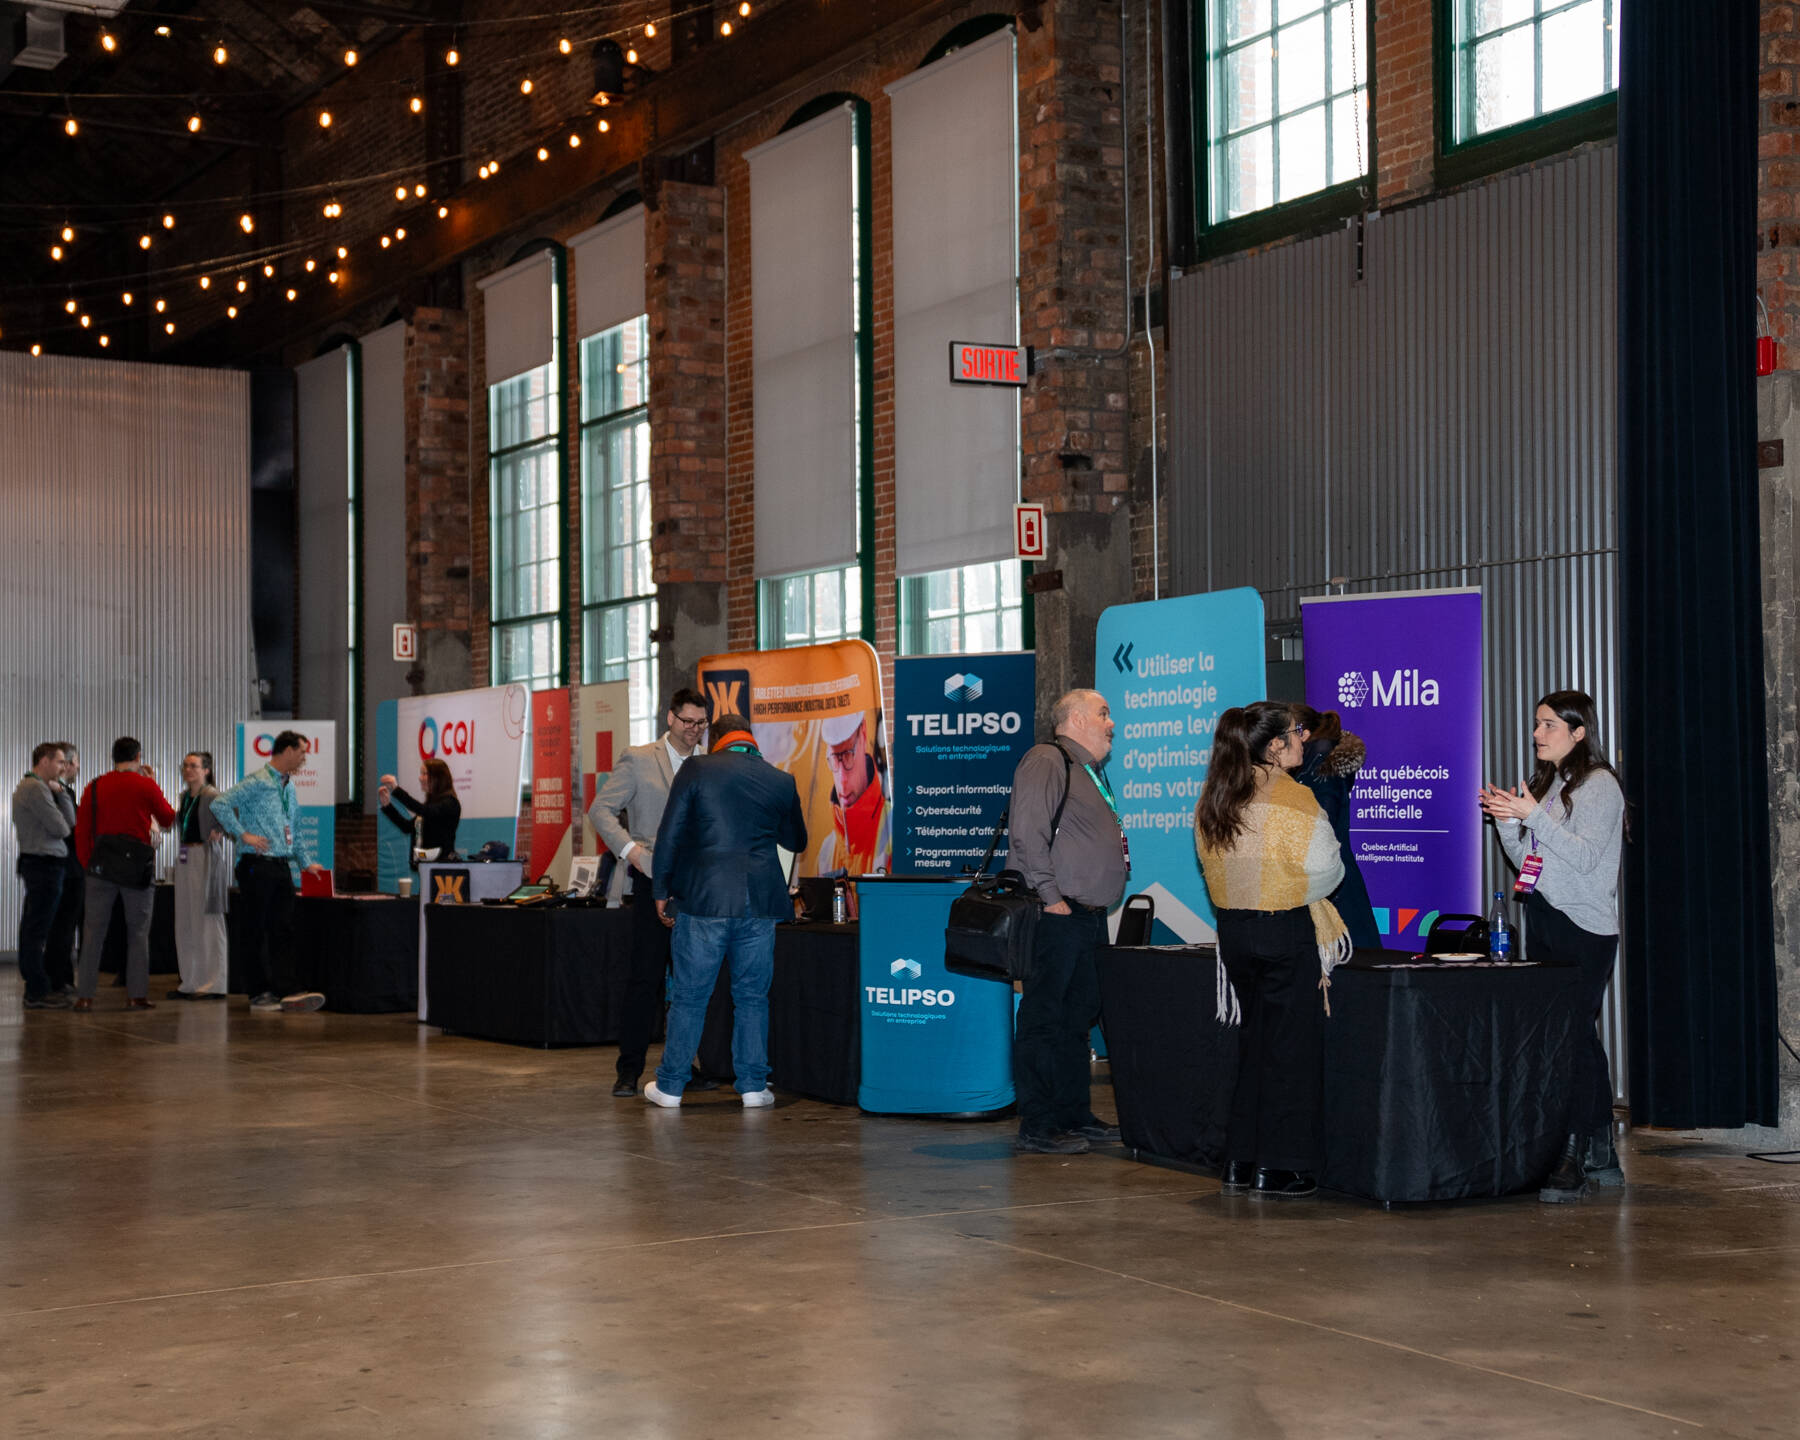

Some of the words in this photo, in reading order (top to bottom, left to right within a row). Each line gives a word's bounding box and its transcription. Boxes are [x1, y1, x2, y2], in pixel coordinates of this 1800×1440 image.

[962, 347, 1019, 381] SORTIE
[1137, 653, 1195, 679] Utiliser
[1199, 651, 1215, 672] la
[1124, 680, 1217, 710] technologie
[1372, 669, 1440, 707] Mila
[753, 702, 767, 715] HIGH
[768, 700, 802, 714] PERFORMANCE
[906, 712, 1021, 736] TELIPSO
[1124, 719, 1183, 739] comme
[1187, 711, 1217, 735] levi
[441, 720, 475, 755] CQI
[915, 745, 951, 753] Solutions
[952, 744, 1011, 754] technologiques
[948, 752, 988, 761] entreprise
[1123, 743, 1213, 774] d'optimisa
[1380, 765, 1449, 783] québécois
[915, 785, 955, 796] Support
[956, 784, 1012, 796] informatiqu
[1123, 780, 1162, 799] dans
[1166, 776, 1206, 797] votr
[1349, 785, 1433, 803] 'intelligence
[915, 805, 982, 817] Cybersécurité
[1122, 805, 1195, 834] entrepris
[1356, 805, 1423, 819] artificielle
[915, 826, 967, 838] Téléphonie
[914, 847, 990, 859] Programmatio
[992, 849, 1009, 857] sur
[1361, 842, 1388, 852] Quebec
[1388, 843, 1418, 852] Artificial
[914, 860, 952, 868] mesure
[1355, 853, 1394, 863] Intelligence
[1395, 854, 1425, 863] Institute
[865, 986, 955, 1007] TELIPSO
